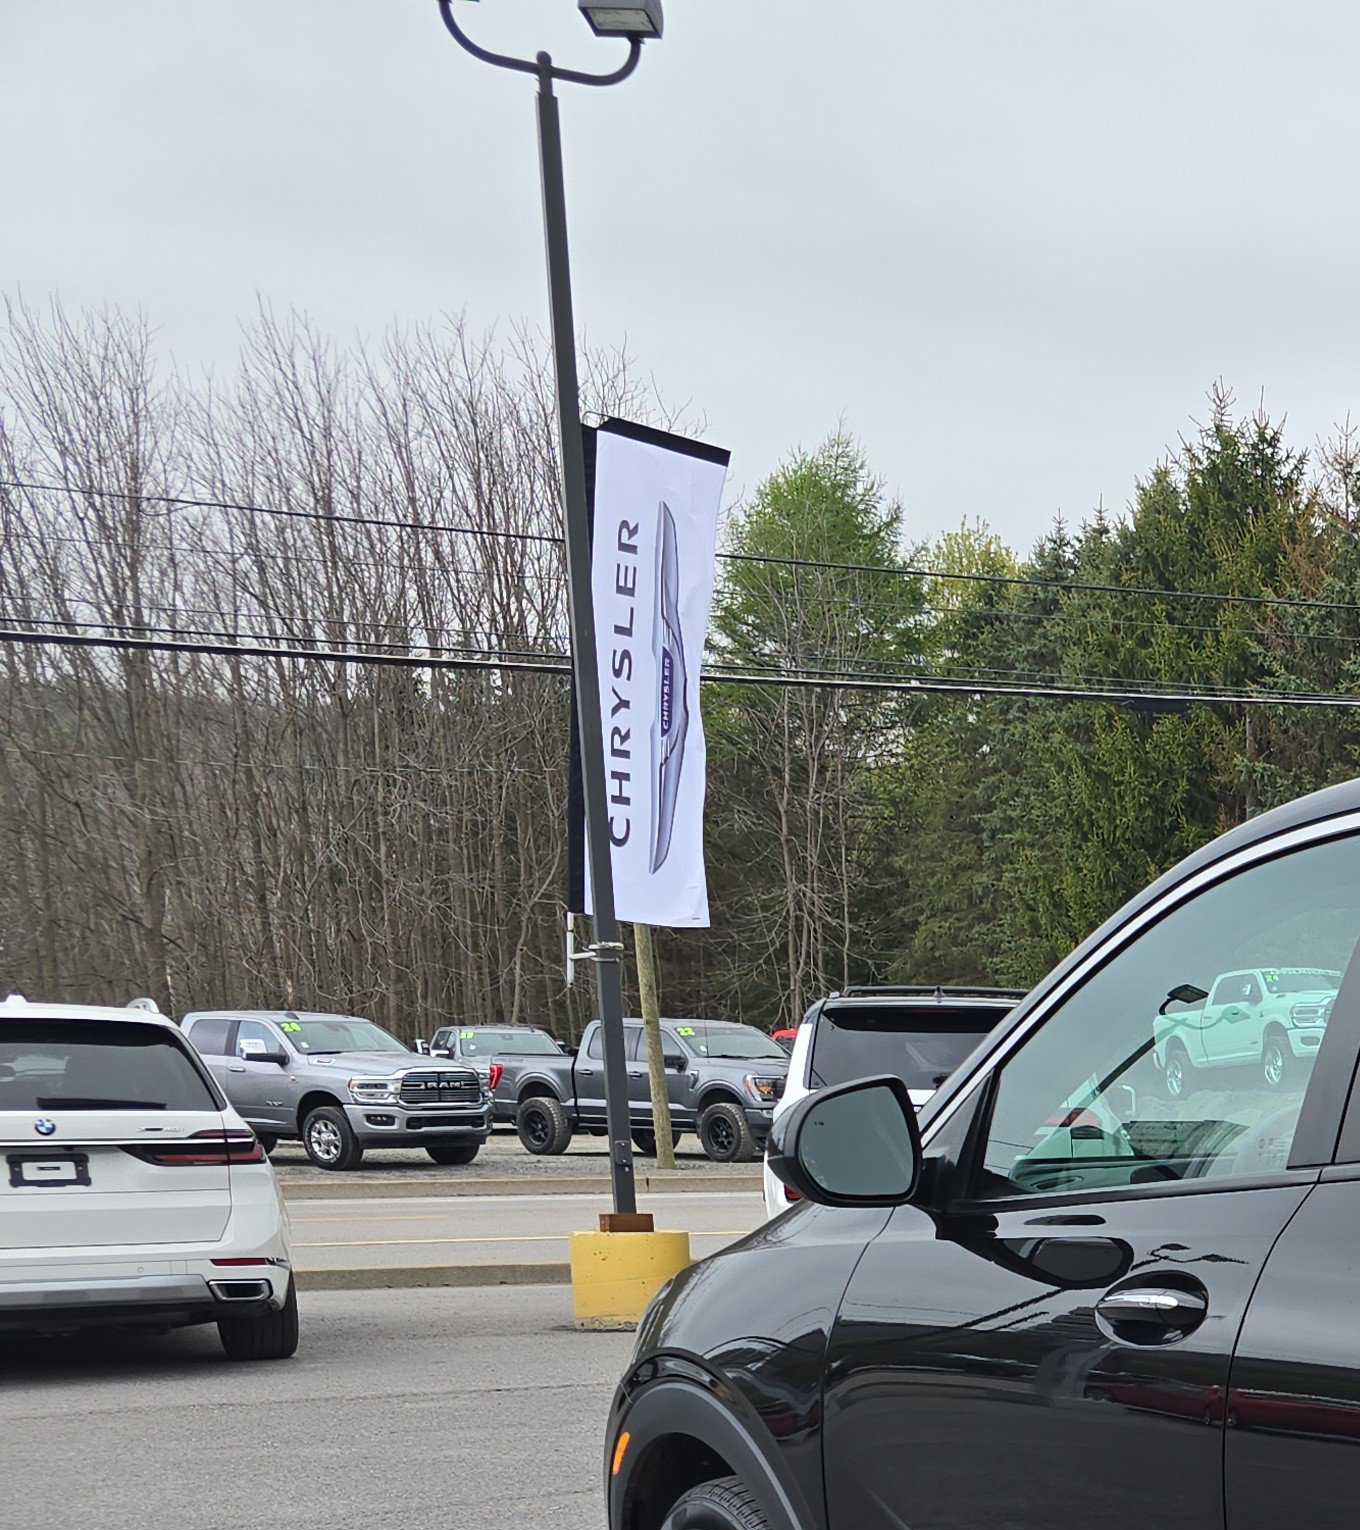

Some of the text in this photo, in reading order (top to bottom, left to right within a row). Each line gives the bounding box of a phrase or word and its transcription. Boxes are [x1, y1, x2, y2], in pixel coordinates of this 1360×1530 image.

[608, 518, 640, 848] CHRYSLER
[663, 656, 673, 730] CHRYSLER
[426, 1081, 461, 1090] RAM
